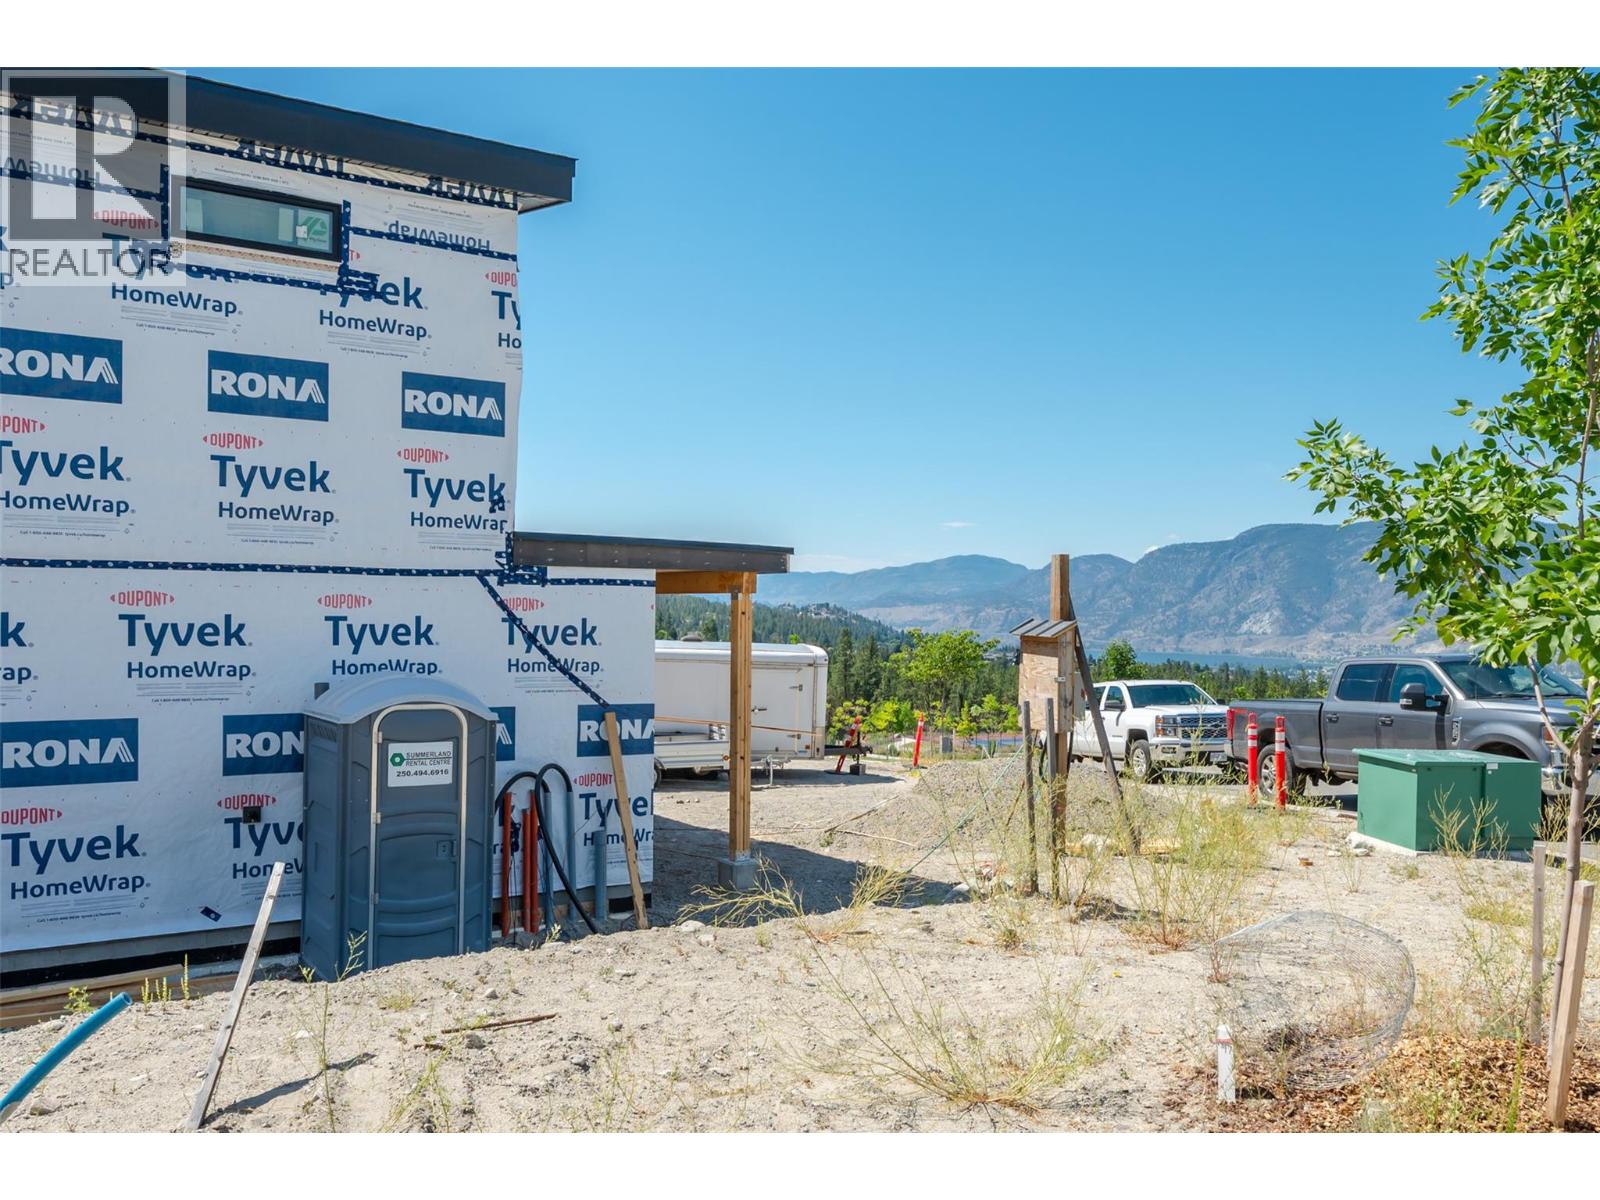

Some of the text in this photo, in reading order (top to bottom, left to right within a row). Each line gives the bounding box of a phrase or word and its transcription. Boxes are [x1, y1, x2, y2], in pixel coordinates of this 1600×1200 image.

[111, 282, 237, 318] HomeWrap
[319, 309, 428, 341] HomeWrap
[0, 347, 119, 385] RONA
[210, 368, 325, 405] RONA
[404, 388, 502, 422] RONA
[209, 432, 258, 450] DUPONT
[403, 447, 445, 464] DUPONT
[210, 454, 330, 498] Tyvek
[403, 467, 506, 509] Tyvek
[218, 501, 335, 527] HomeWrap
[117, 590, 169, 607] DUPONT
[324, 593, 368, 609] DUPONT
[118, 613, 247, 657] Tyvek
[324, 615, 434, 655] Tyvek
[501, 617, 598, 654] Tyvek
[127, 660, 251, 681] HomeWrap
[2, 736, 135, 769] RONA
[226, 730, 305, 759] RON
[406, 750, 452, 759] SUMMERLAND
[579, 773, 613, 787] DUPONT
[1, 807, 56, 825] DUPONT
[224, 793, 271, 810] DUPONT
[1, 824, 140, 875] Tyvek
[11, 874, 146, 900] HomeWrap
